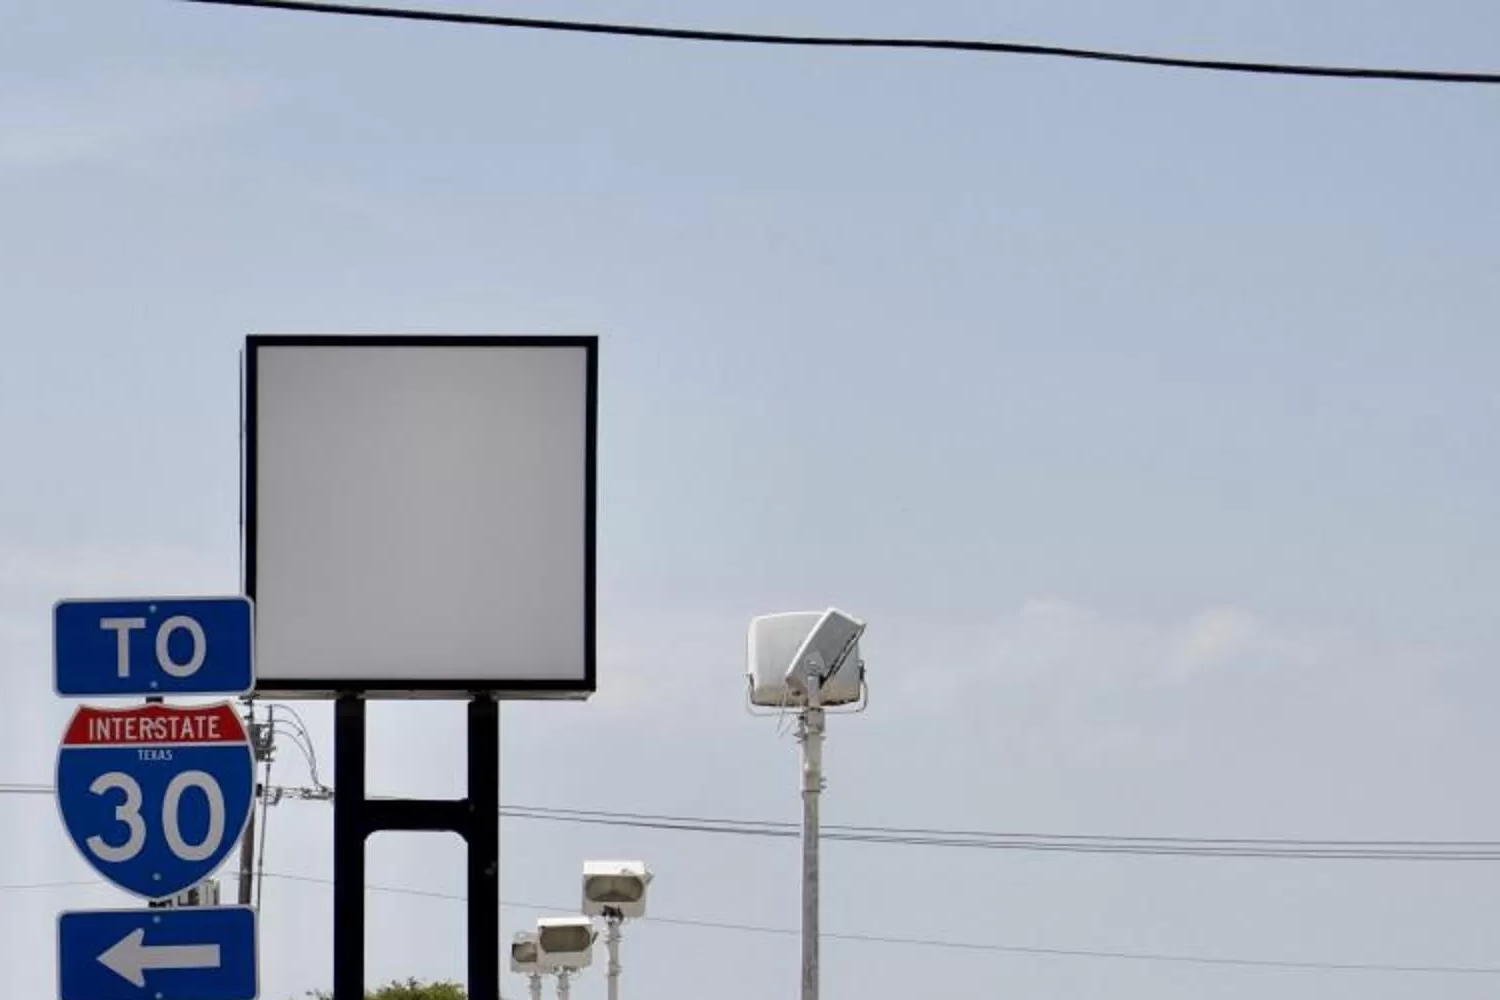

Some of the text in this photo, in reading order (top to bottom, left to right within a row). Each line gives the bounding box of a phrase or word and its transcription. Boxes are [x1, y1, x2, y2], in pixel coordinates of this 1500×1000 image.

[100, 615, 207, 677] TO
[88, 715, 222, 741] INTERSTATE
[137, 749, 173, 761] TEXAS
[87, 770, 225, 863] 30
